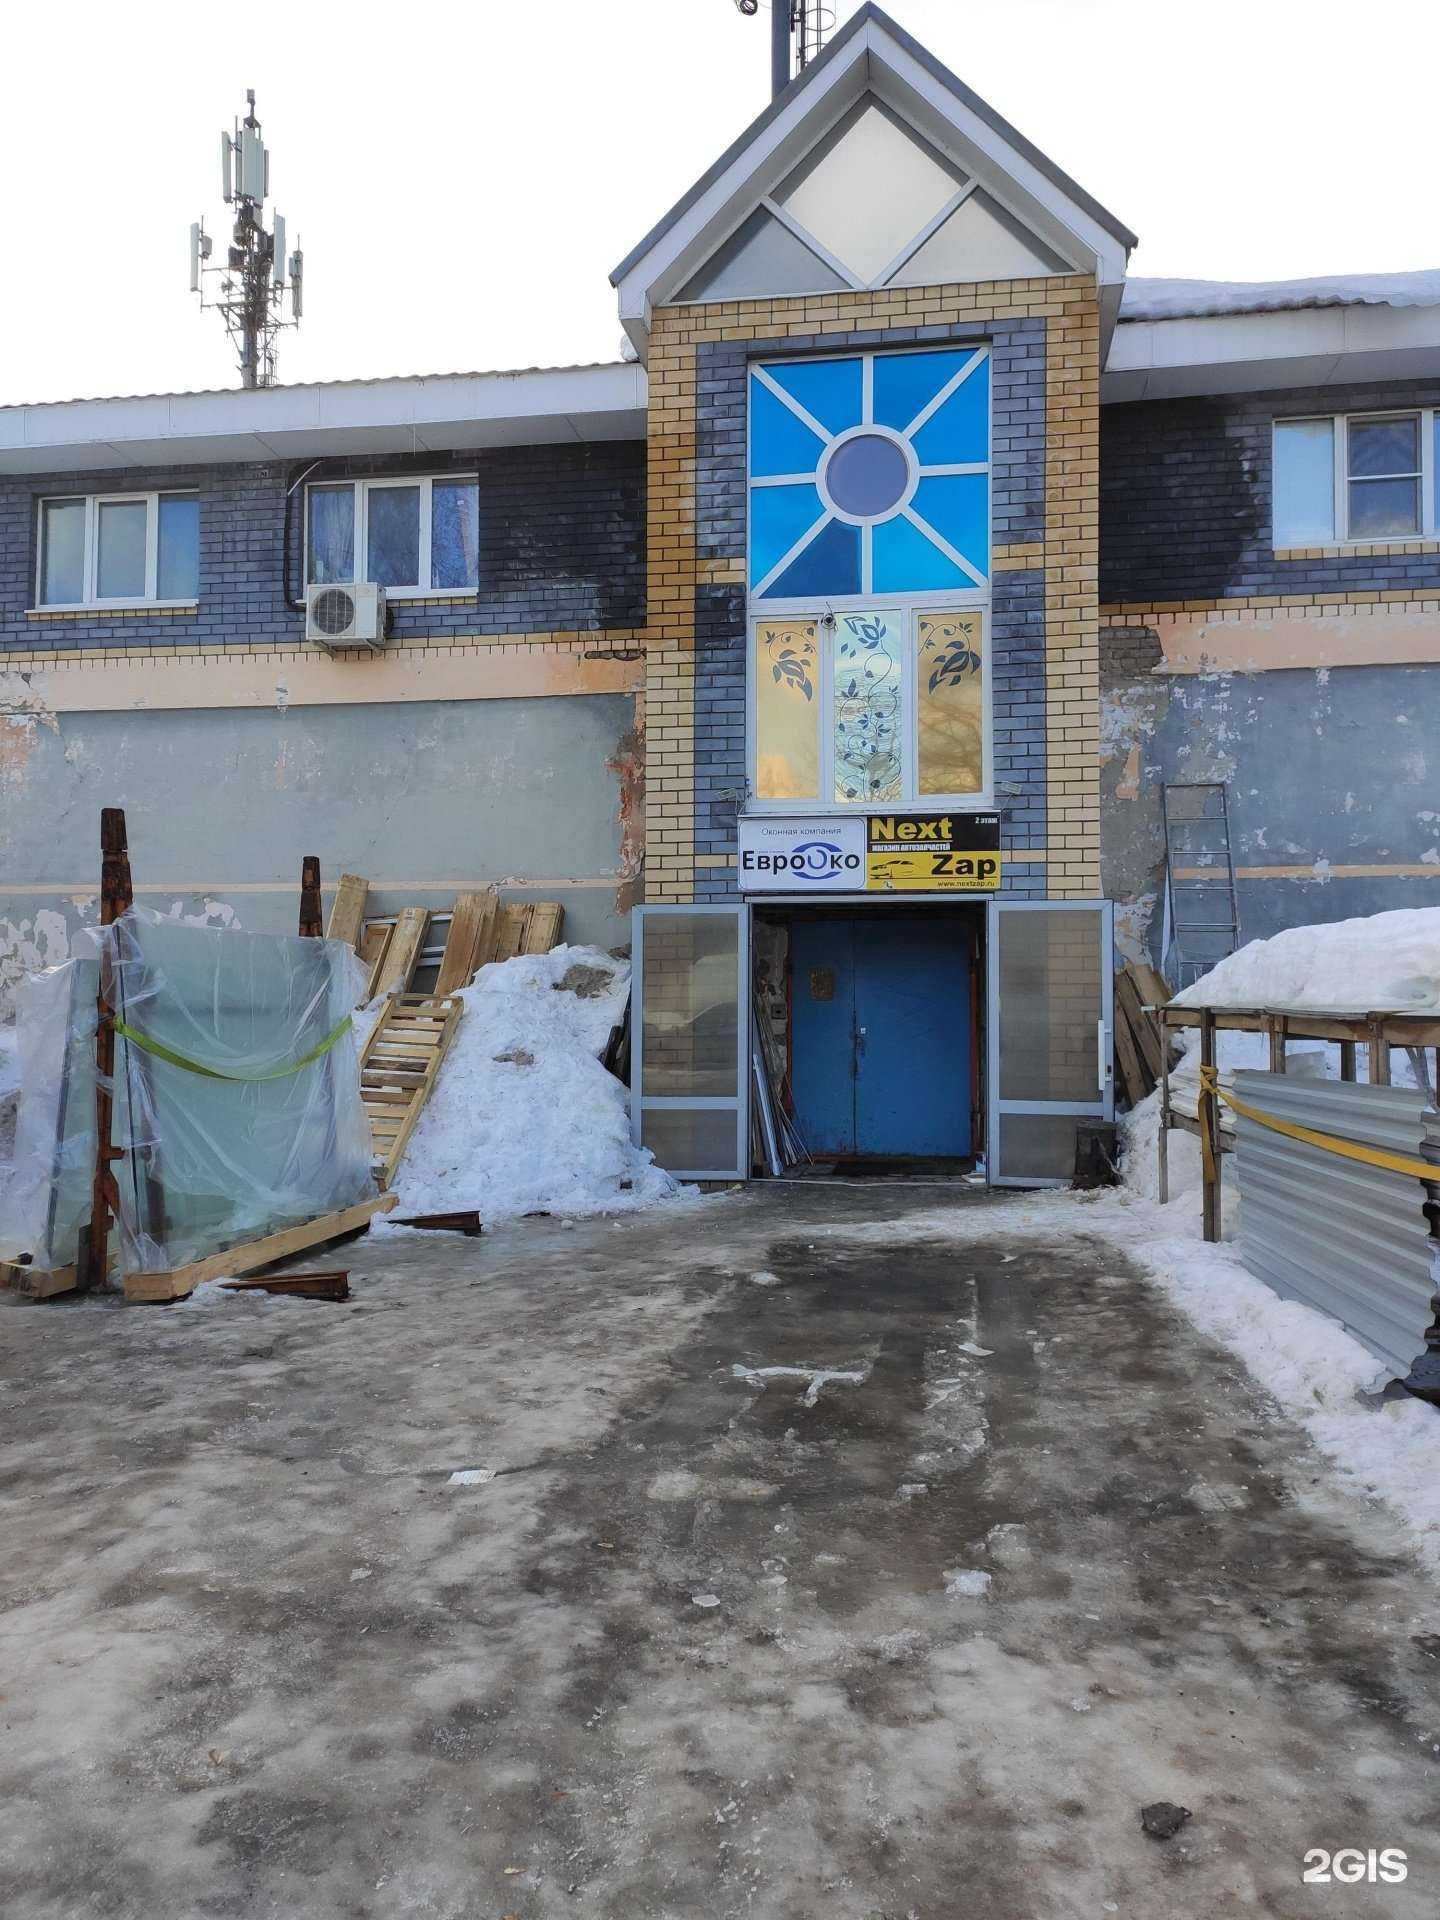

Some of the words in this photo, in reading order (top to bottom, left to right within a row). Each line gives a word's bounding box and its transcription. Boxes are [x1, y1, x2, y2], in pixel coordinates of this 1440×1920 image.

[974, 816, 980, 824] 2
[761, 827, 798, 836] Оконная
[800, 827, 841, 835] компания
[871, 816, 953, 840] Next
[931, 854, 997, 880] Zap
[937, 880, 995, 888] www.nextzap.ru
